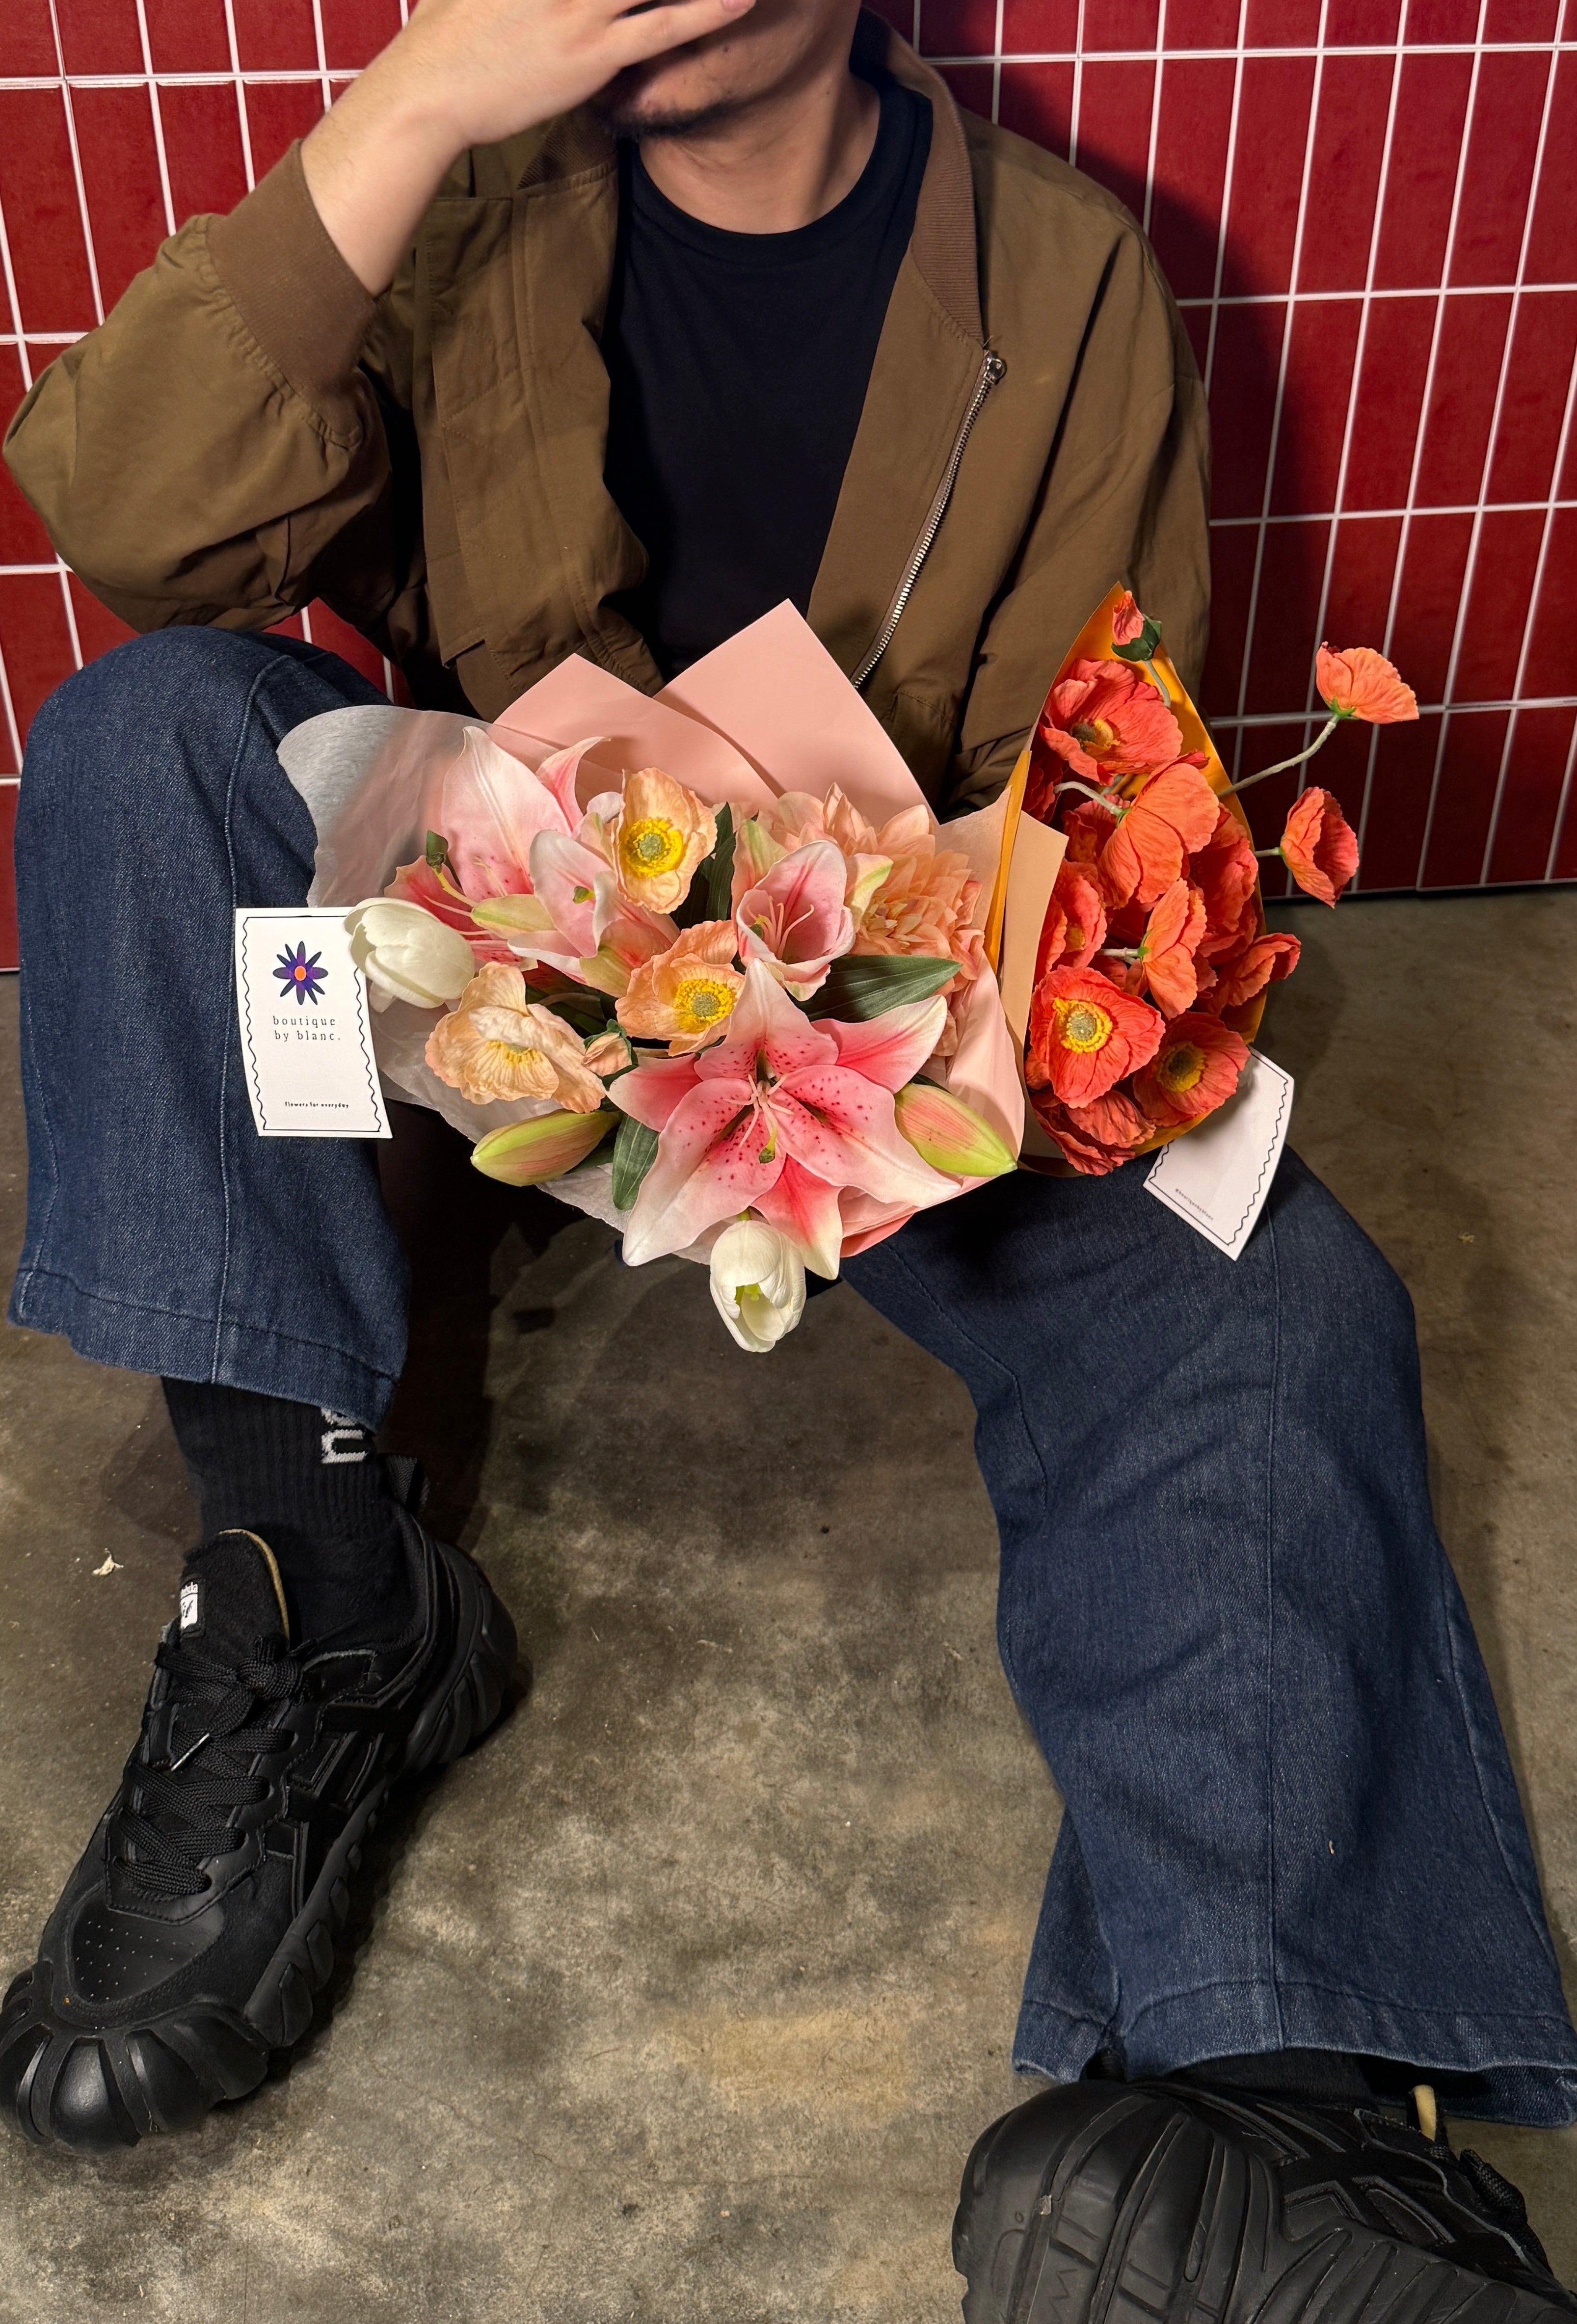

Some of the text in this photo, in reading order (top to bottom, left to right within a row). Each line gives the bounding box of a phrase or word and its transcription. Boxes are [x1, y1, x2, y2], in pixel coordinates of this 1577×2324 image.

[272, 1015, 335, 1029] boutique
[274, 1030, 340, 1042] by blanc.
